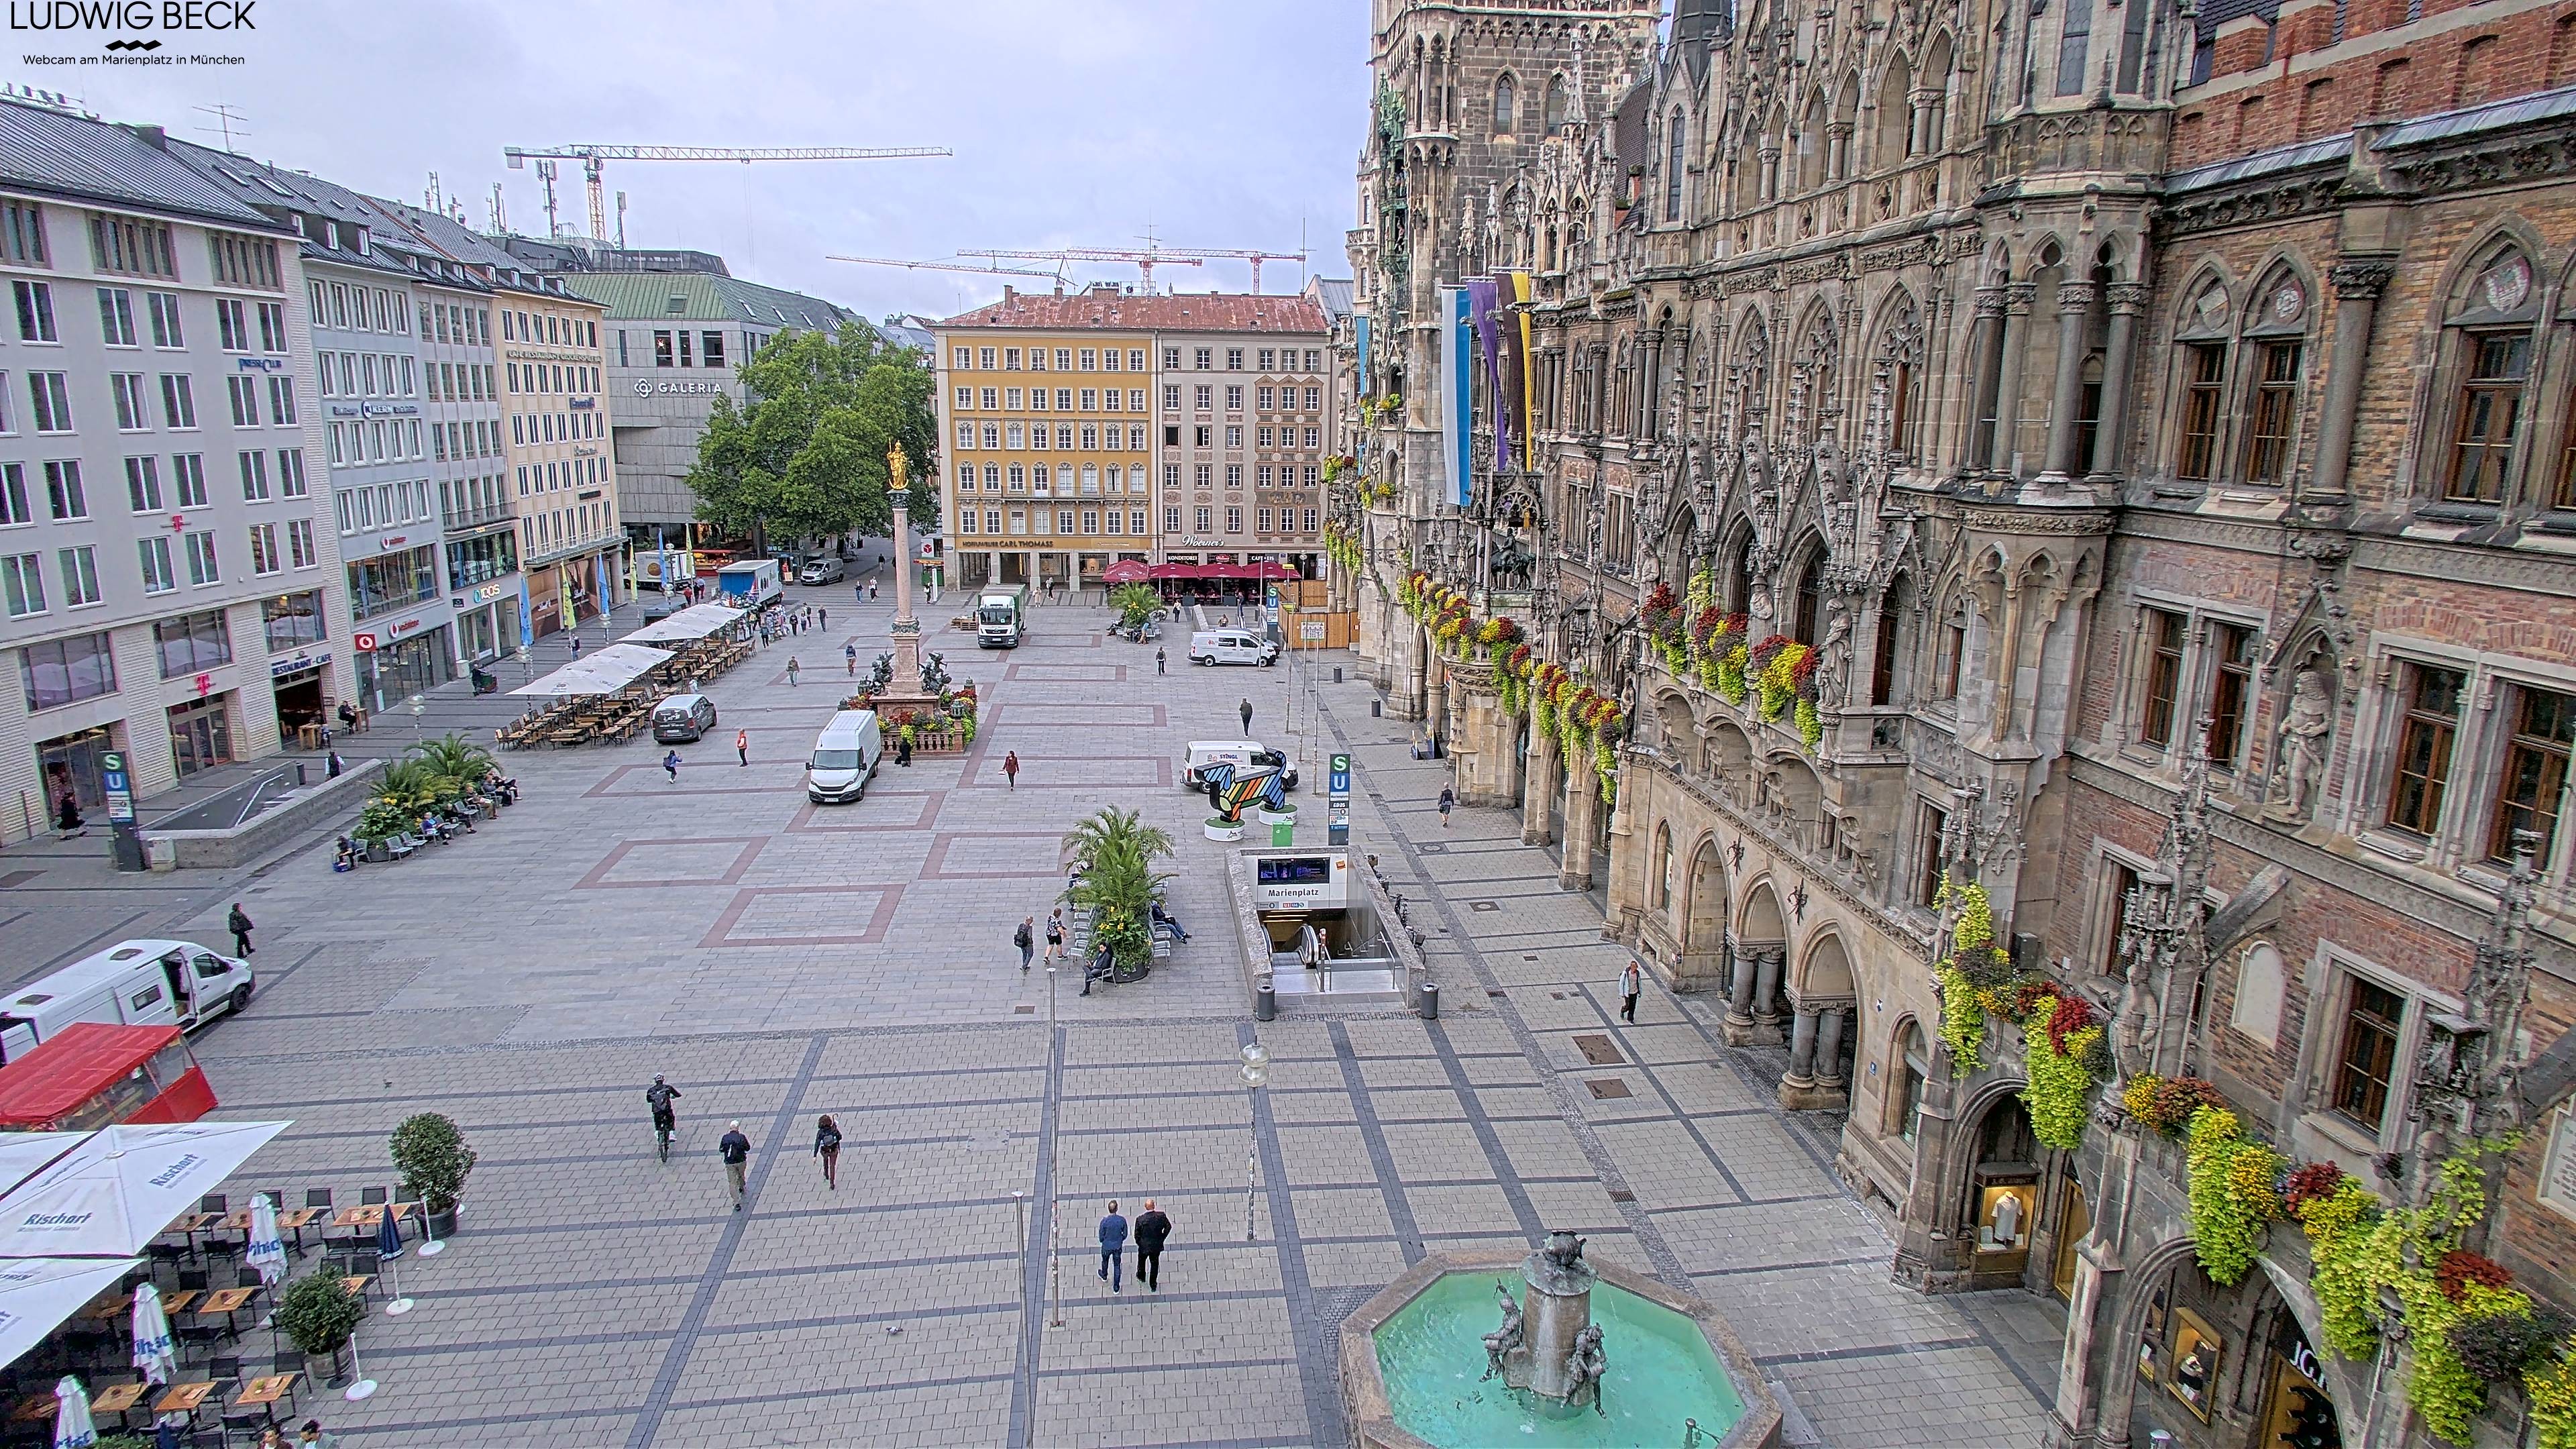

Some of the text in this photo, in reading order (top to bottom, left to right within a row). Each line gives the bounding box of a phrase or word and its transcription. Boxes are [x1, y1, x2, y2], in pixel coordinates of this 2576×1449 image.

[658, 382, 722, 393] GALERIA
[480, 584, 500, 599] IQOS
[1269, 588, 1277, 596] S
[1269, 598, 1277, 606] U
[105, 754, 121, 769] S
[1334, 756, 1346, 771] S
[108, 774, 121, 788] U
[1334, 775, 1345, 789] U
[1268, 888, 1319, 898] Marienplatz
[149, 1154, 199, 1186] Rischart
[23, 1212, 93, 1225] Rischart
